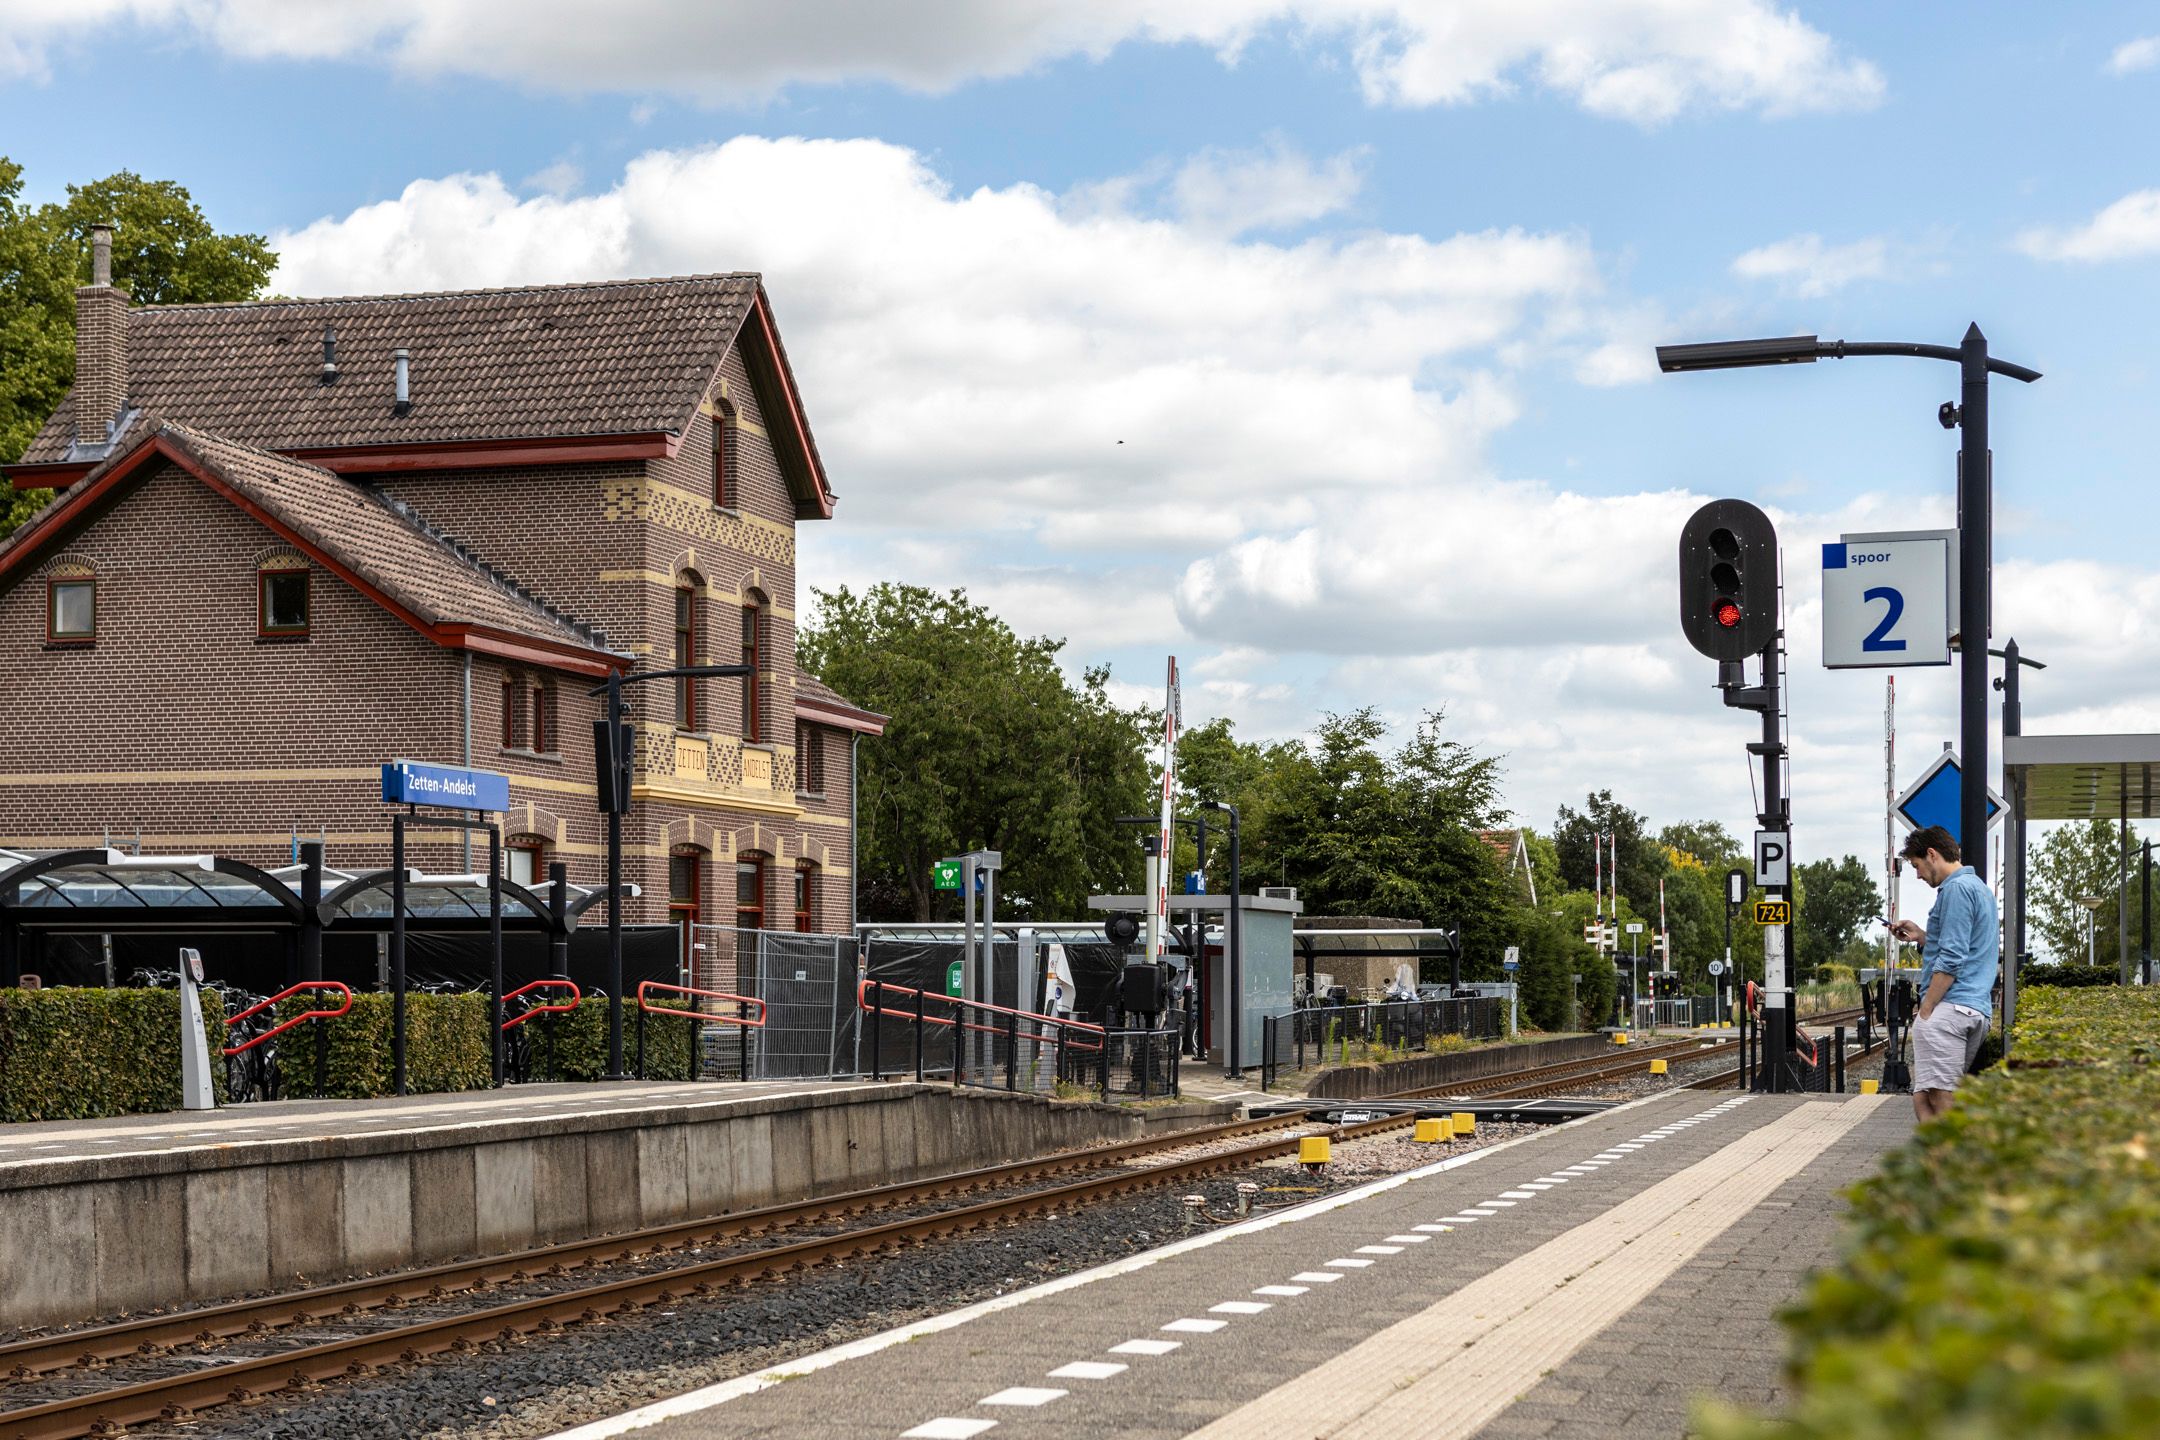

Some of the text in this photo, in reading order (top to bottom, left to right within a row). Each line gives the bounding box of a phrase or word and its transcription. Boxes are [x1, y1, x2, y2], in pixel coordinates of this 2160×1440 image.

[1851, 552, 1891, 566] spoor
[1863, 586, 1906, 652] 2
[678, 747, 705, 771] ZETTEN
[743, 758, 770, 780] ANDELST
[408, 774, 477, 796] Zetten-Andelst
[1761, 842, 1784, 875] P
[1760, 905, 1785, 921] 724
